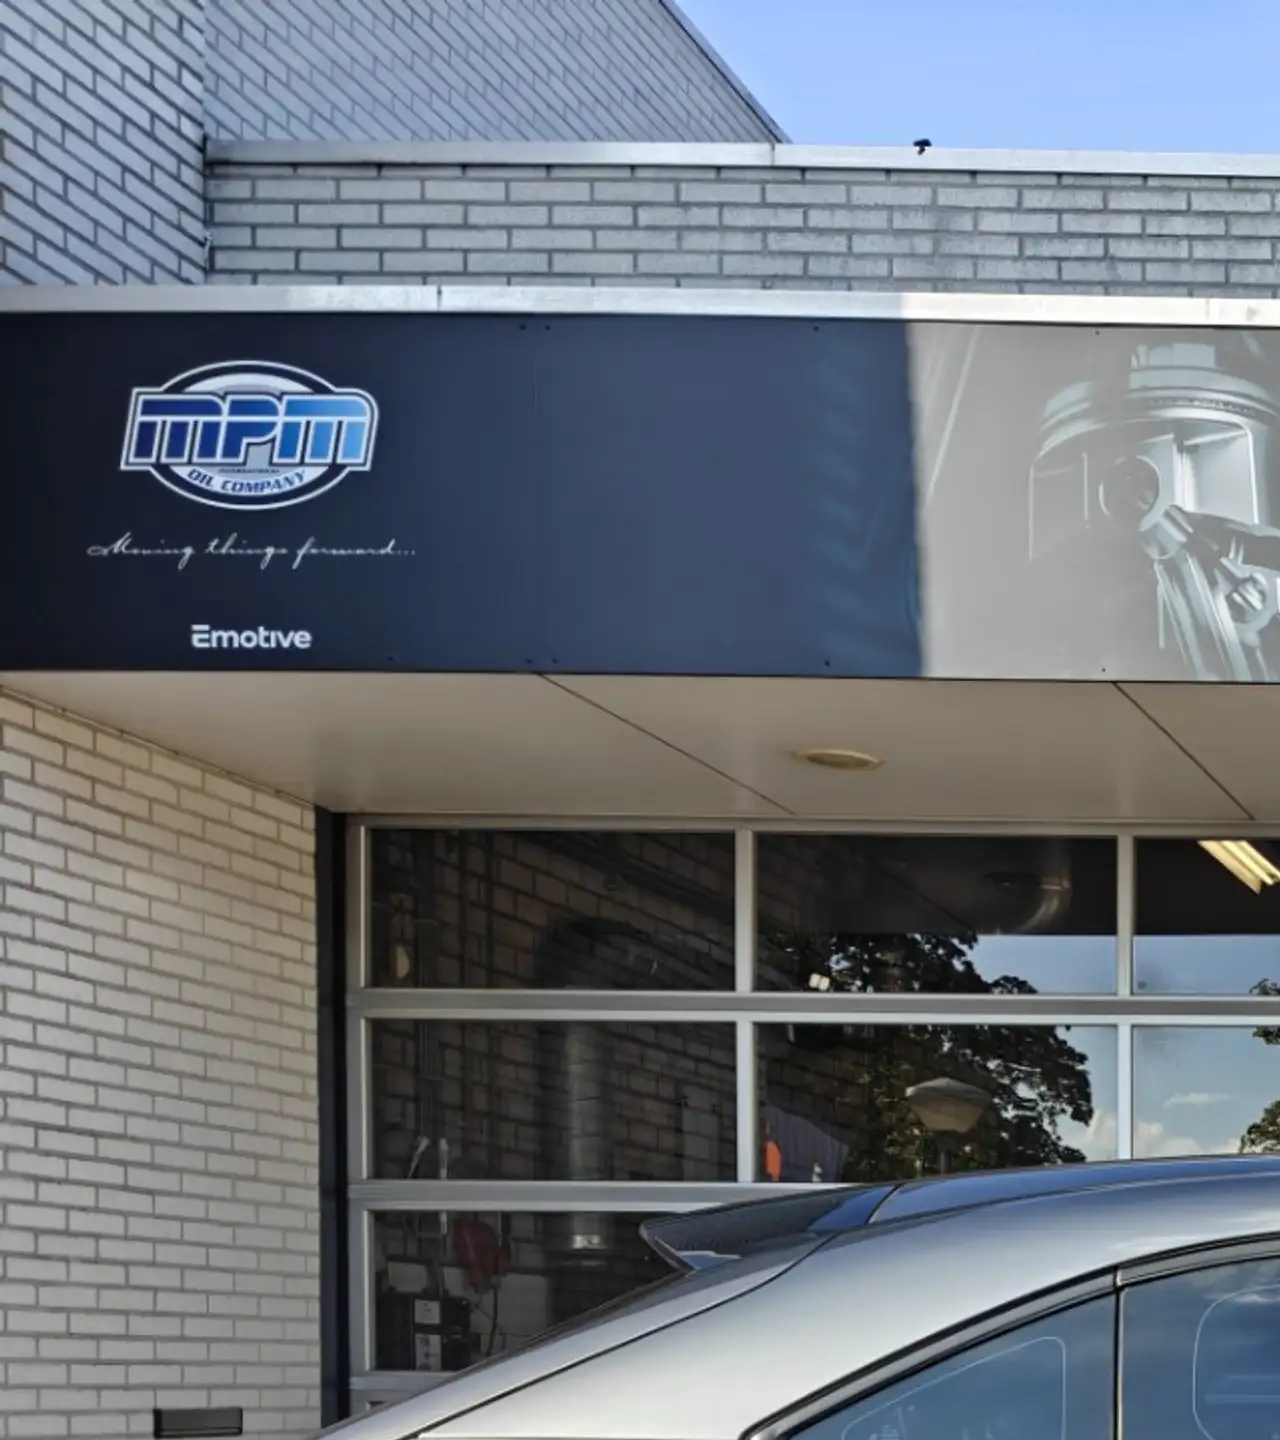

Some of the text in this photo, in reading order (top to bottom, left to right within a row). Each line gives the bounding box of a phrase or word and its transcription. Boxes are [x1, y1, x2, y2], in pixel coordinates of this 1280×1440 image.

[186, 468, 306, 494] OIL COMPANY
[205, 533, 288, 570] things
[190, 623, 312, 649] Emotive
